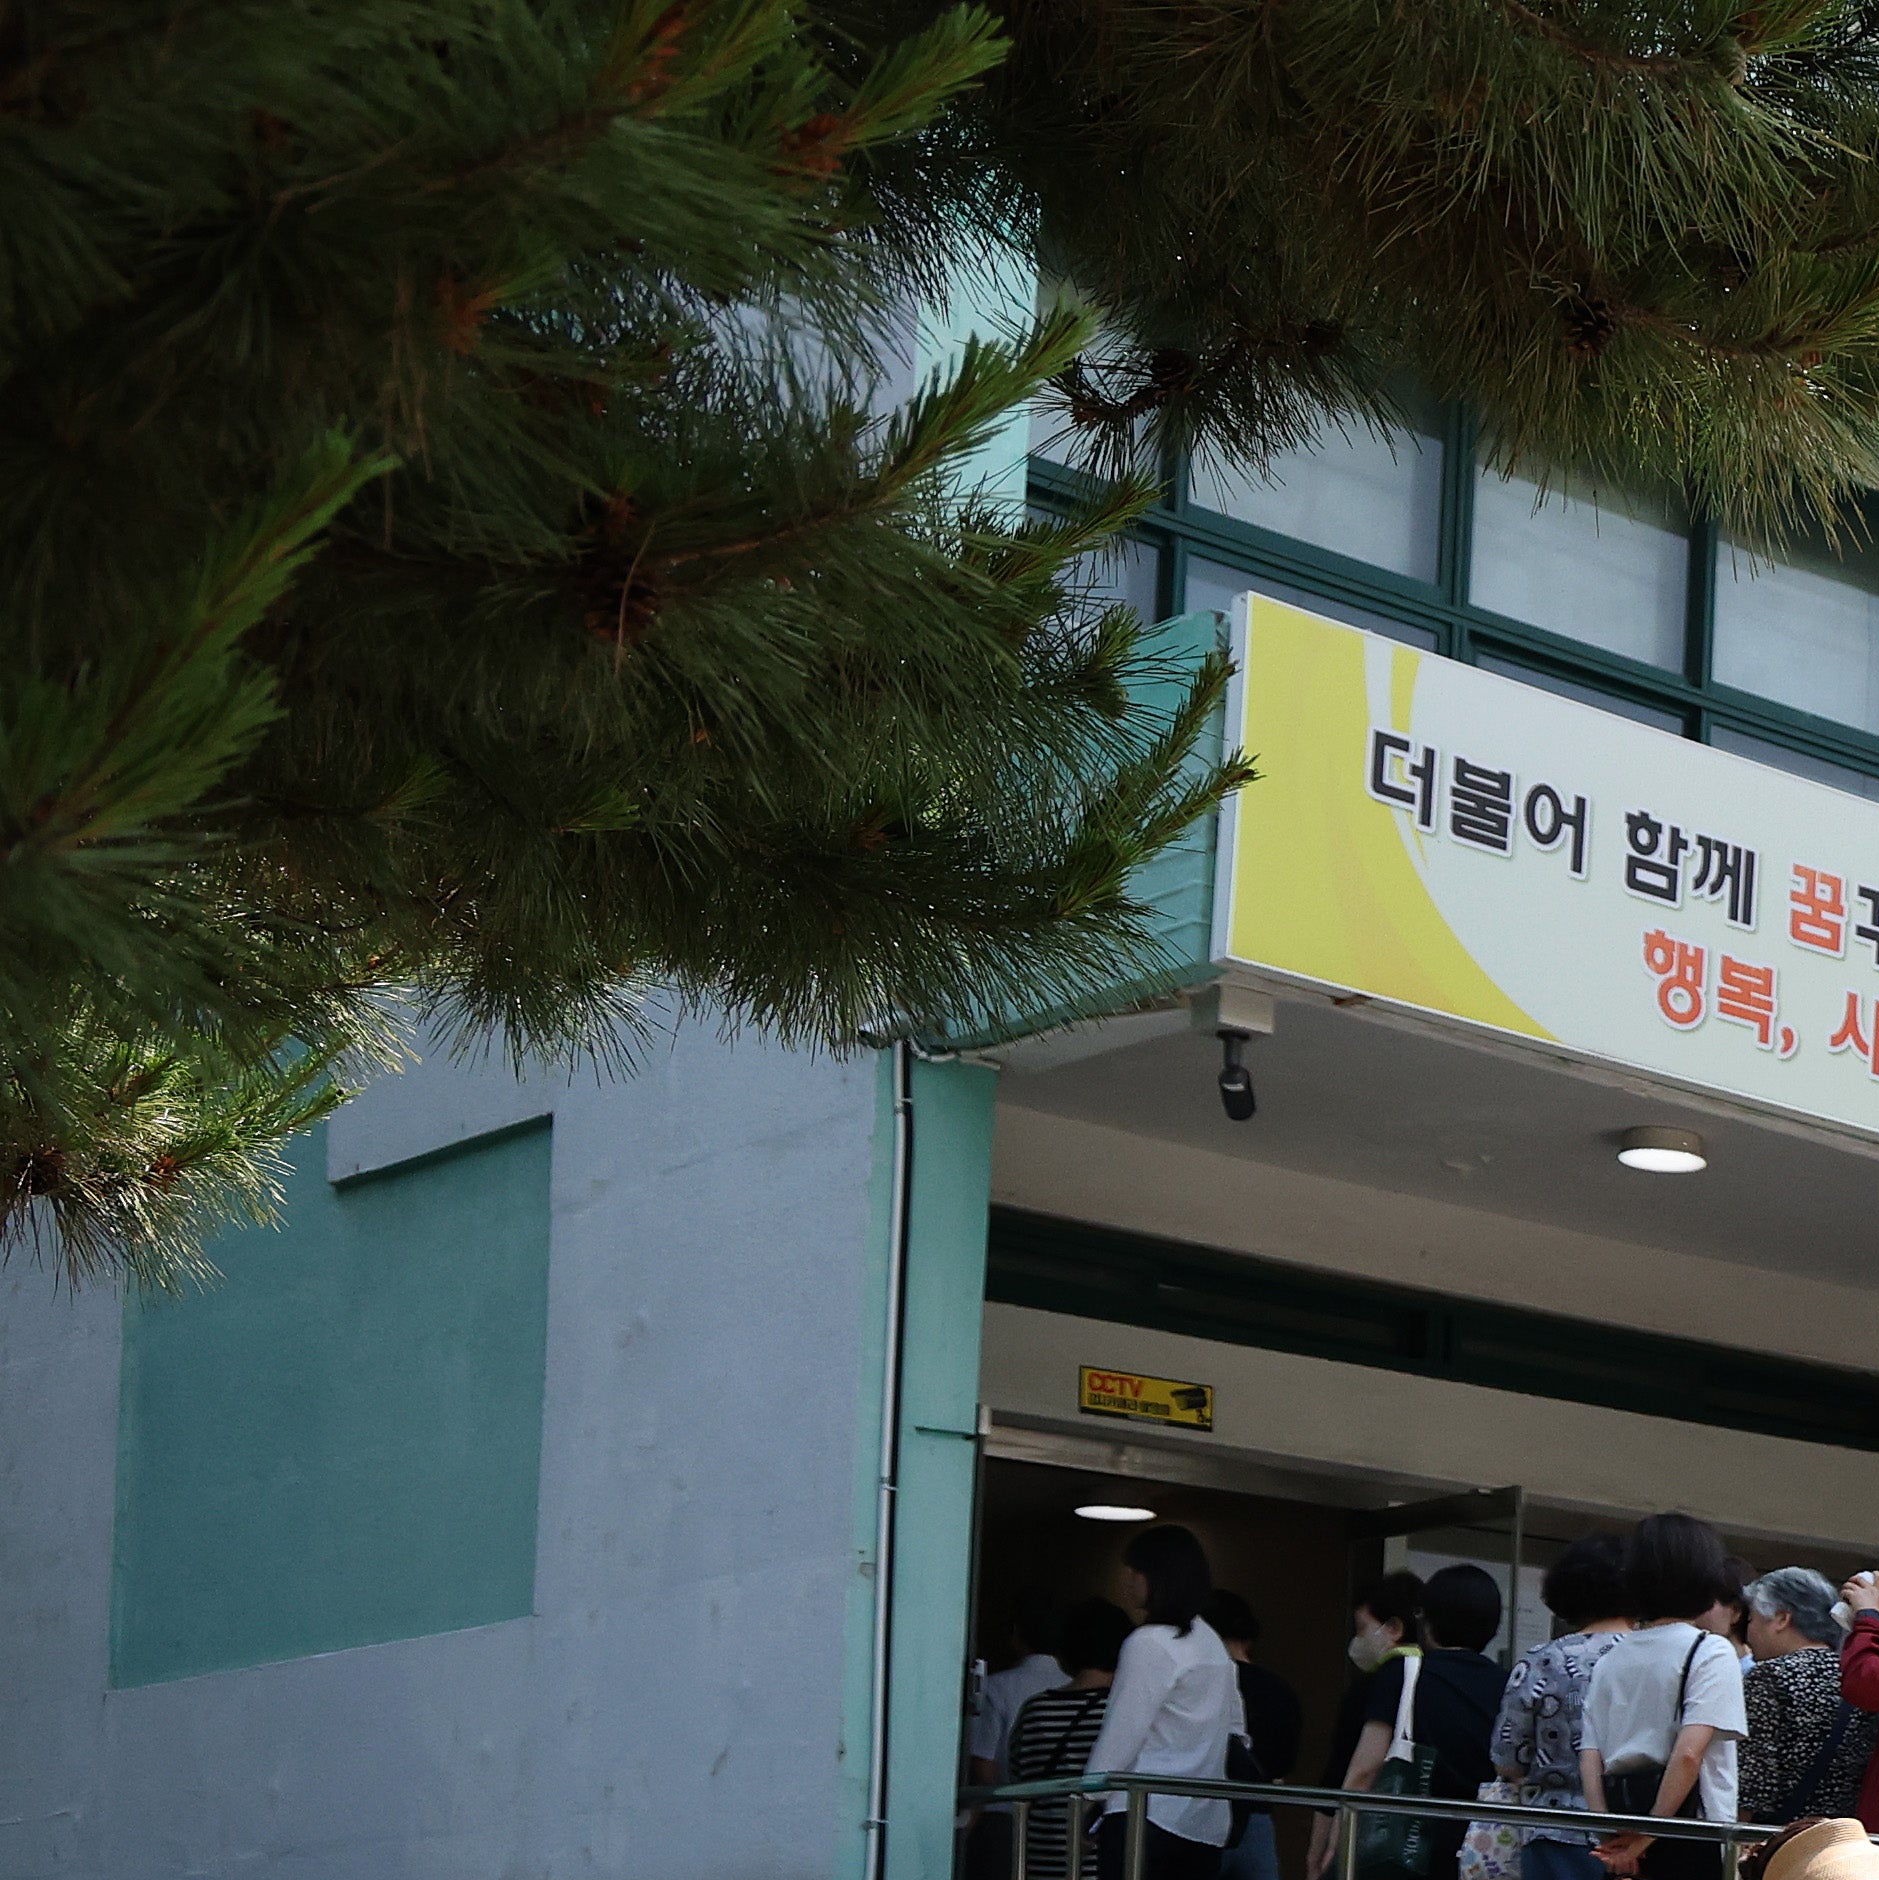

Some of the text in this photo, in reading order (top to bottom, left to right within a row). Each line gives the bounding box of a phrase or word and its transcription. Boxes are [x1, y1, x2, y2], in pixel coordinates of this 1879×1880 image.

[1371, 729, 1587, 875] 더불어
[1625, 810, 1757, 926] 함께
[1643, 928, 1796, 1056] 행복,
[1088, 1372, 1144, 1397] CCTV
